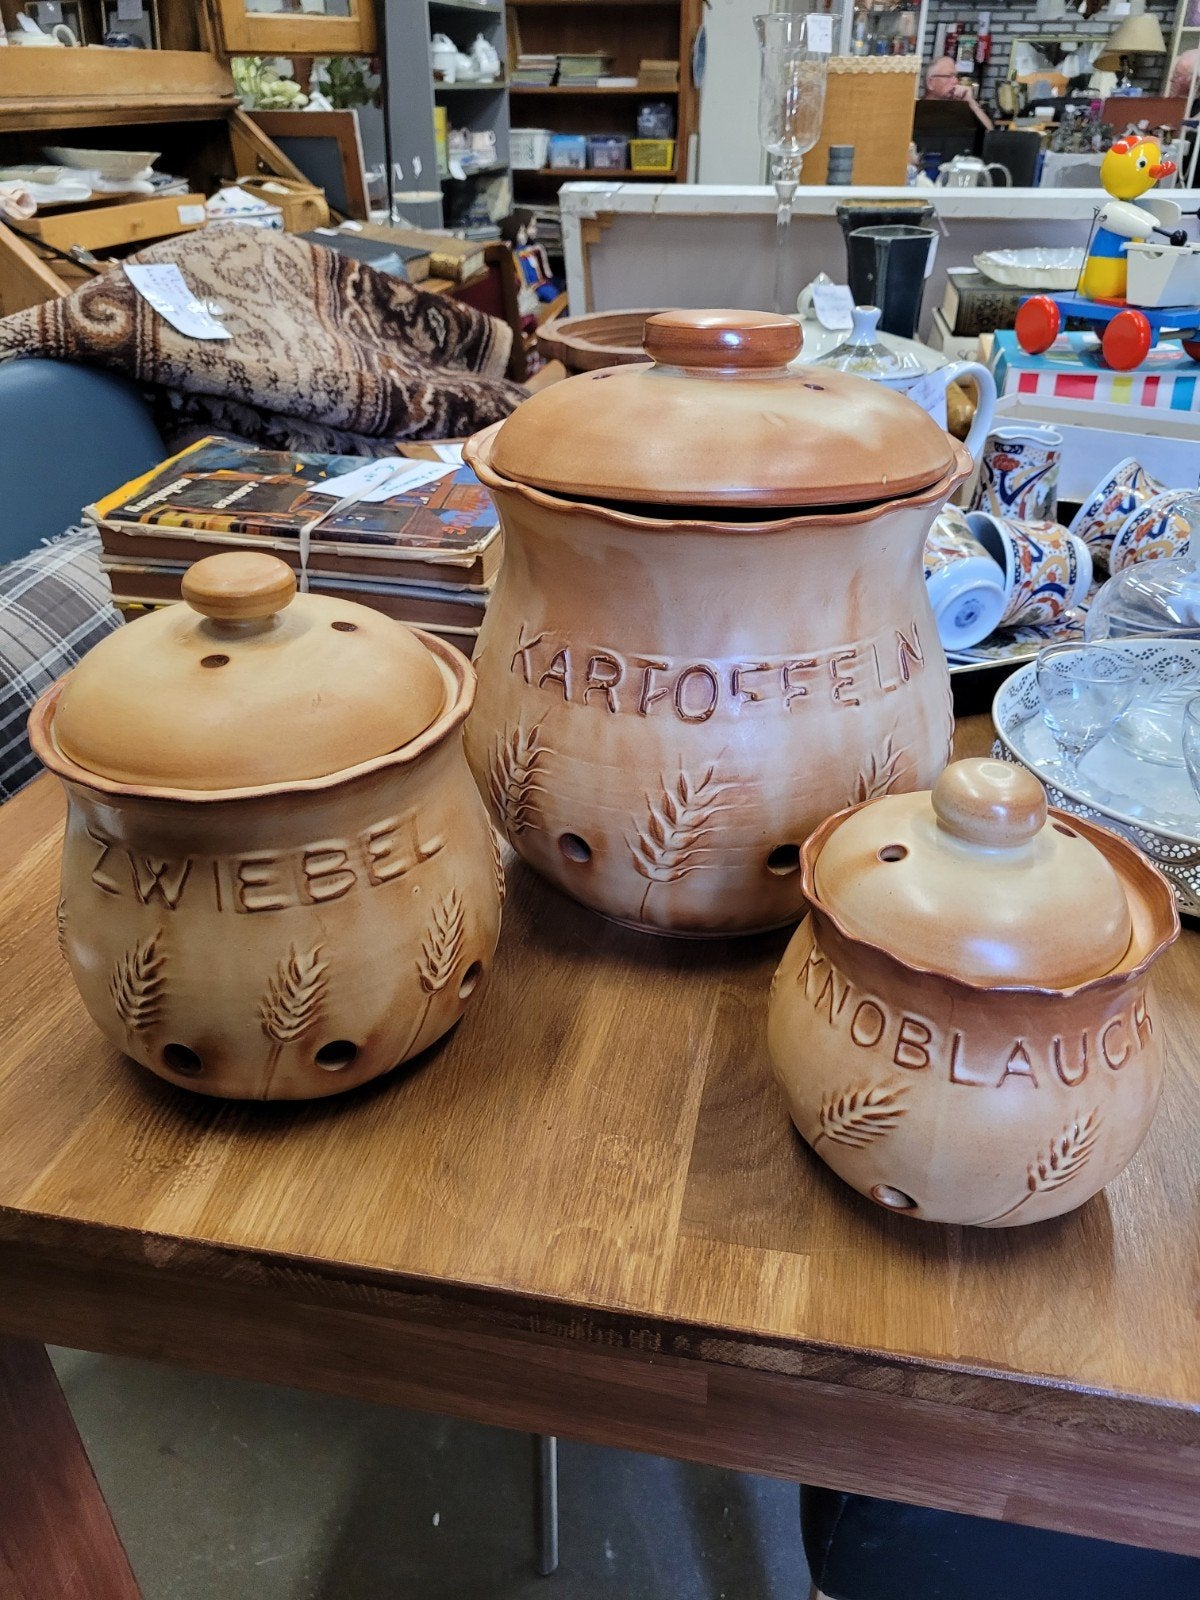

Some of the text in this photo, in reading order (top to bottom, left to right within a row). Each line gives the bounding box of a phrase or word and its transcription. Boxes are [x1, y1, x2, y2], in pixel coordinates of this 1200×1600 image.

[509, 621, 925, 724] KARTOFFELN
[85, 812, 446, 914] ZWIEBEL
[796, 944, 1153, 1089] KNOBLAUCH
